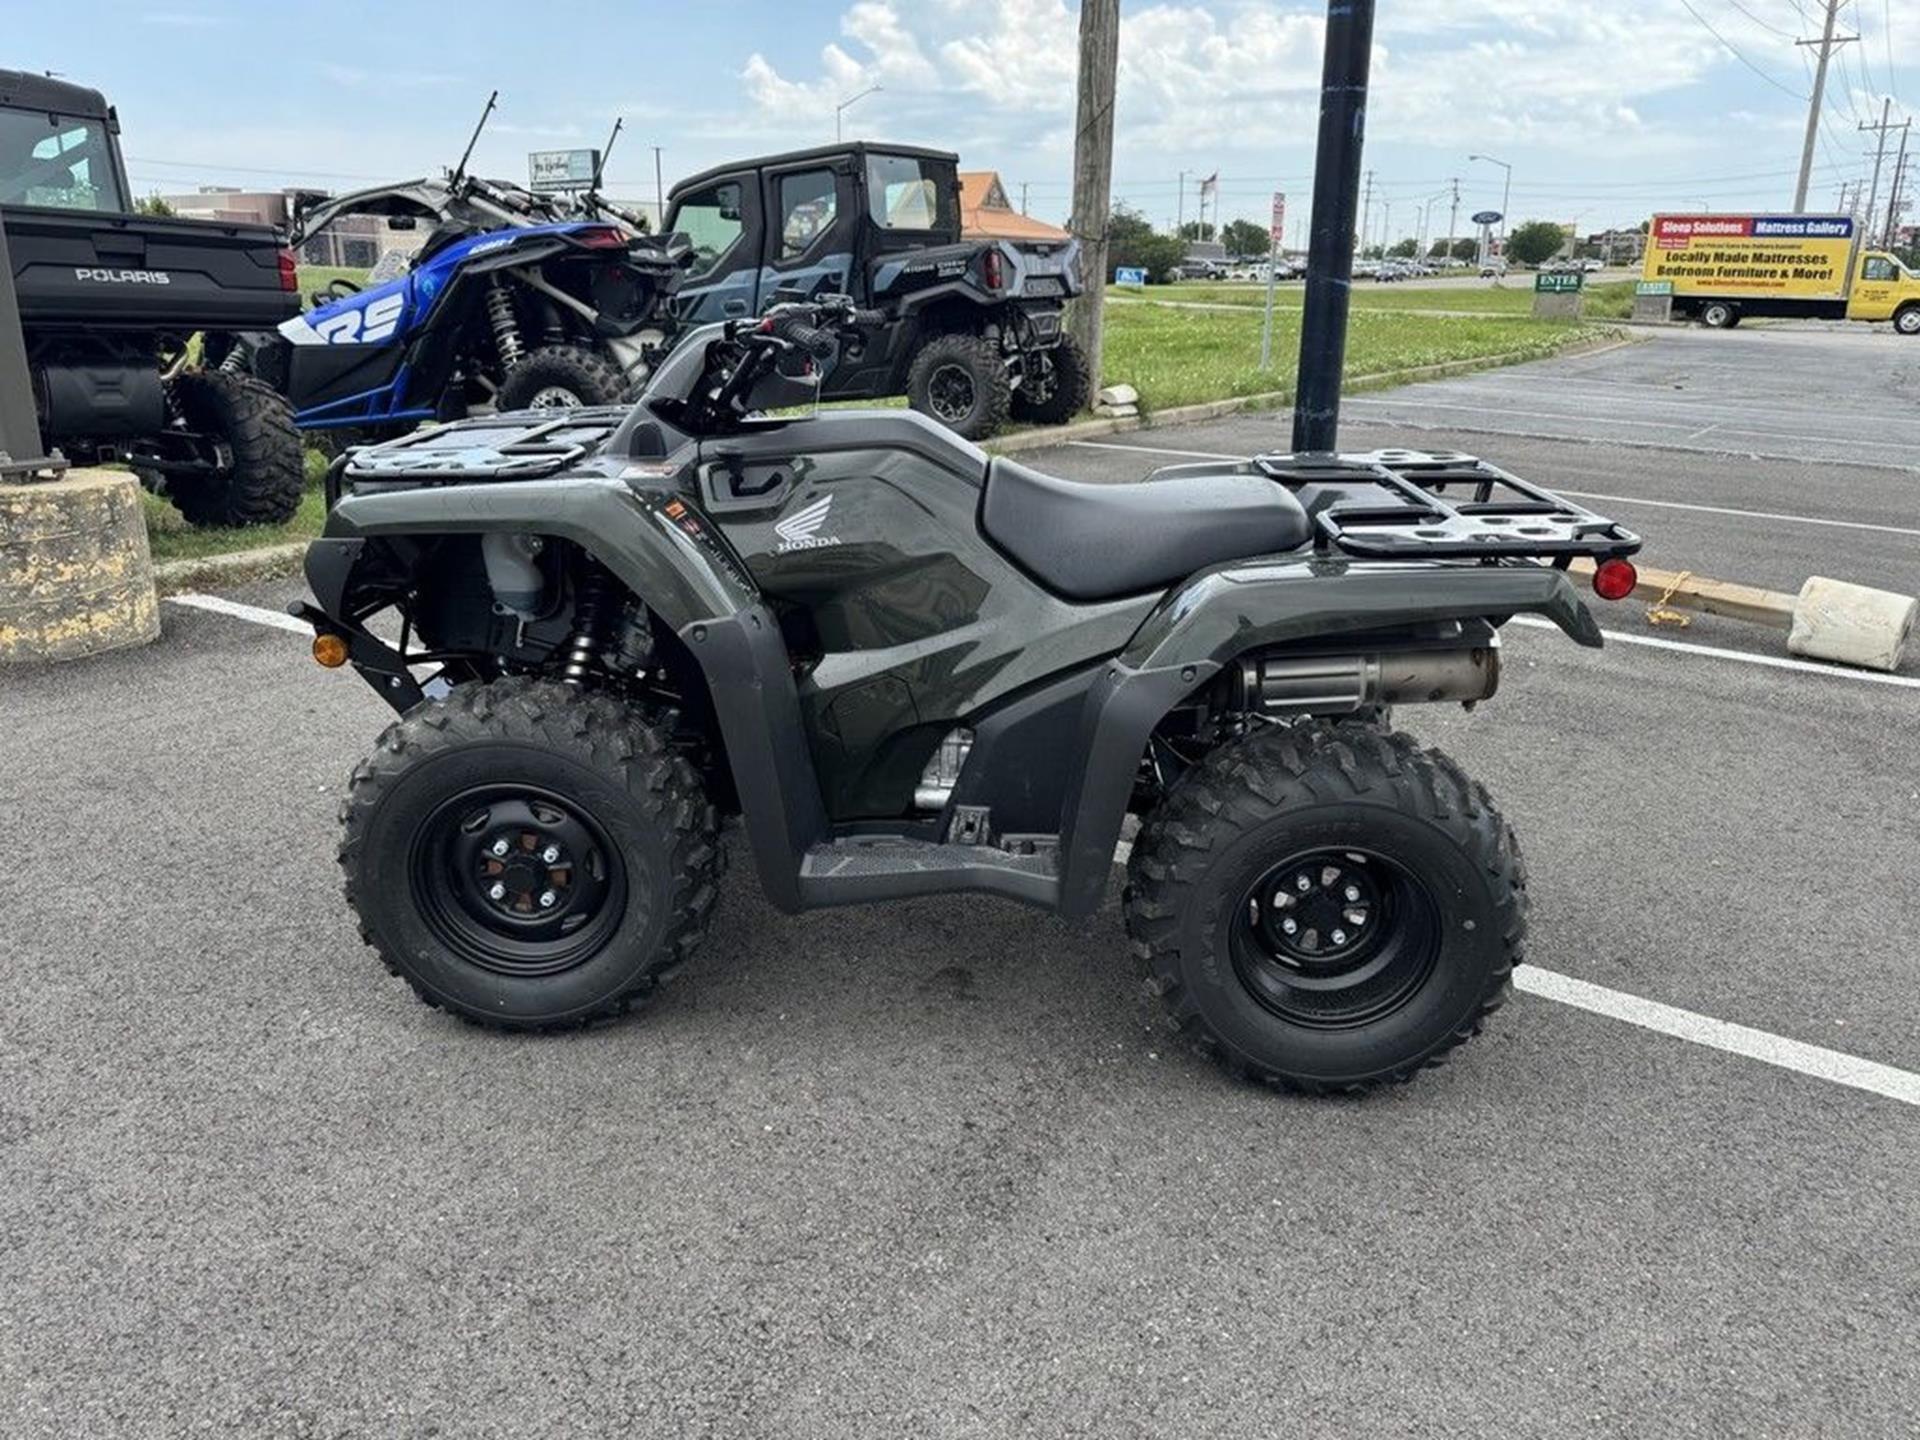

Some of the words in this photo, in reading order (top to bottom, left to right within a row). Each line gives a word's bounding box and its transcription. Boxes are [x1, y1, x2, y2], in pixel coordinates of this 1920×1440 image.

[1662, 221, 1692, 234] Sleep
[1693, 221, 1743, 234] Solutions
[1755, 221, 1804, 234] Mattress
[1806, 221, 1849, 236] Gallery
[1665, 251, 1711, 264] Locally
[1713, 251, 1749, 263] Made
[1752, 252, 1828, 265] Mattresses
[75, 268, 170, 285] POLARIS
[1657, 265, 1715, 276] Bedroom
[1716, 266, 1778, 279] Furniture
[1780, 269, 1789, 279] &
[1791, 268, 1833, 280] More!
[1539, 275, 1578, 286] ENTER
[316, 291, 404, 344] RS
[777, 535, 843, 551] HONDA
